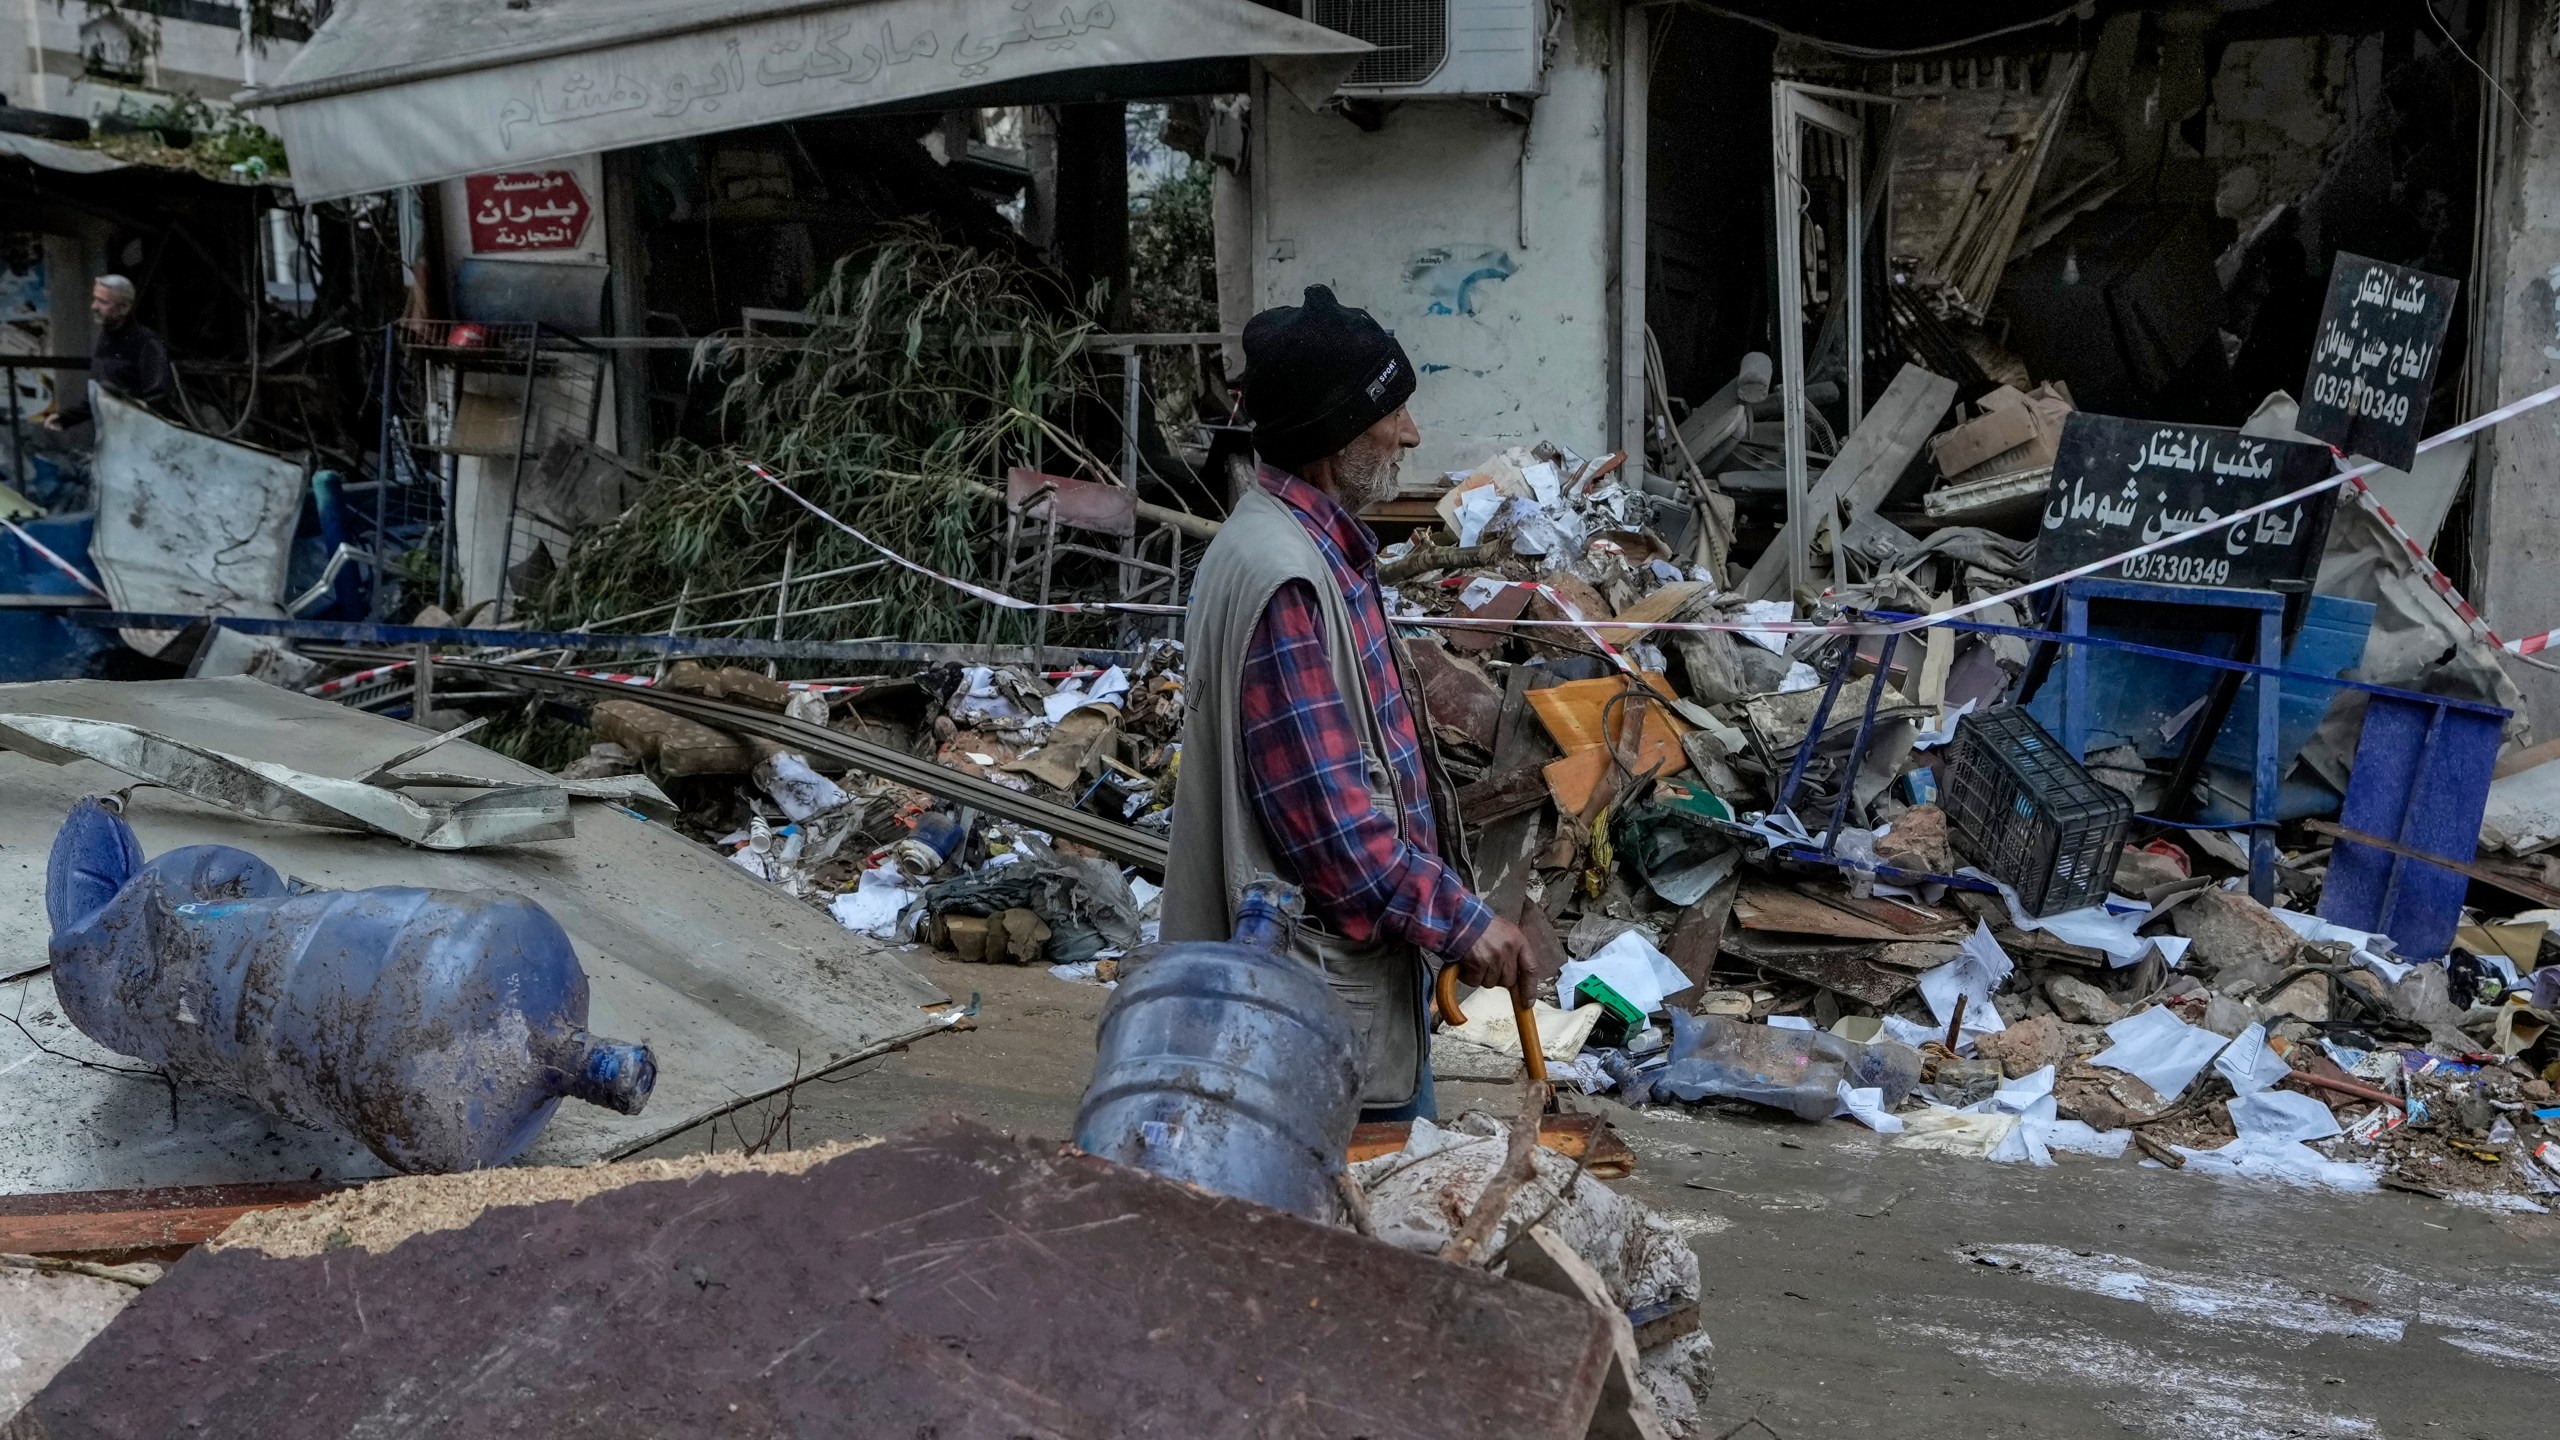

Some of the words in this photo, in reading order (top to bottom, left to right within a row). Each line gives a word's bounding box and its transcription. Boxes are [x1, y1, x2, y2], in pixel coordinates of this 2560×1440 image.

[757, 20, 939, 87] ماركت
[952, 0, 1116, 78] ميني
[498, 71, 649, 151] هشام
[476, 198, 579, 225] بدران
[2351, 266, 2395, 308] المختار
[2391, 275, 2427, 320] مكتب
[2316, 310, 2360, 368] شومان
[2387, 337, 2435, 386] الحاج
[1379, 358, 1397, 382] SPORT
[2313, 372, 2410, 427] 03/30349
[2127, 428, 2210, 473] المختار
[2212, 439, 2273, 486] مكتب
[2043, 476, 2140, 530] شومان
[2141, 490, 2220, 545] حسن
[2121, 552, 2230, 585] 03/330349
